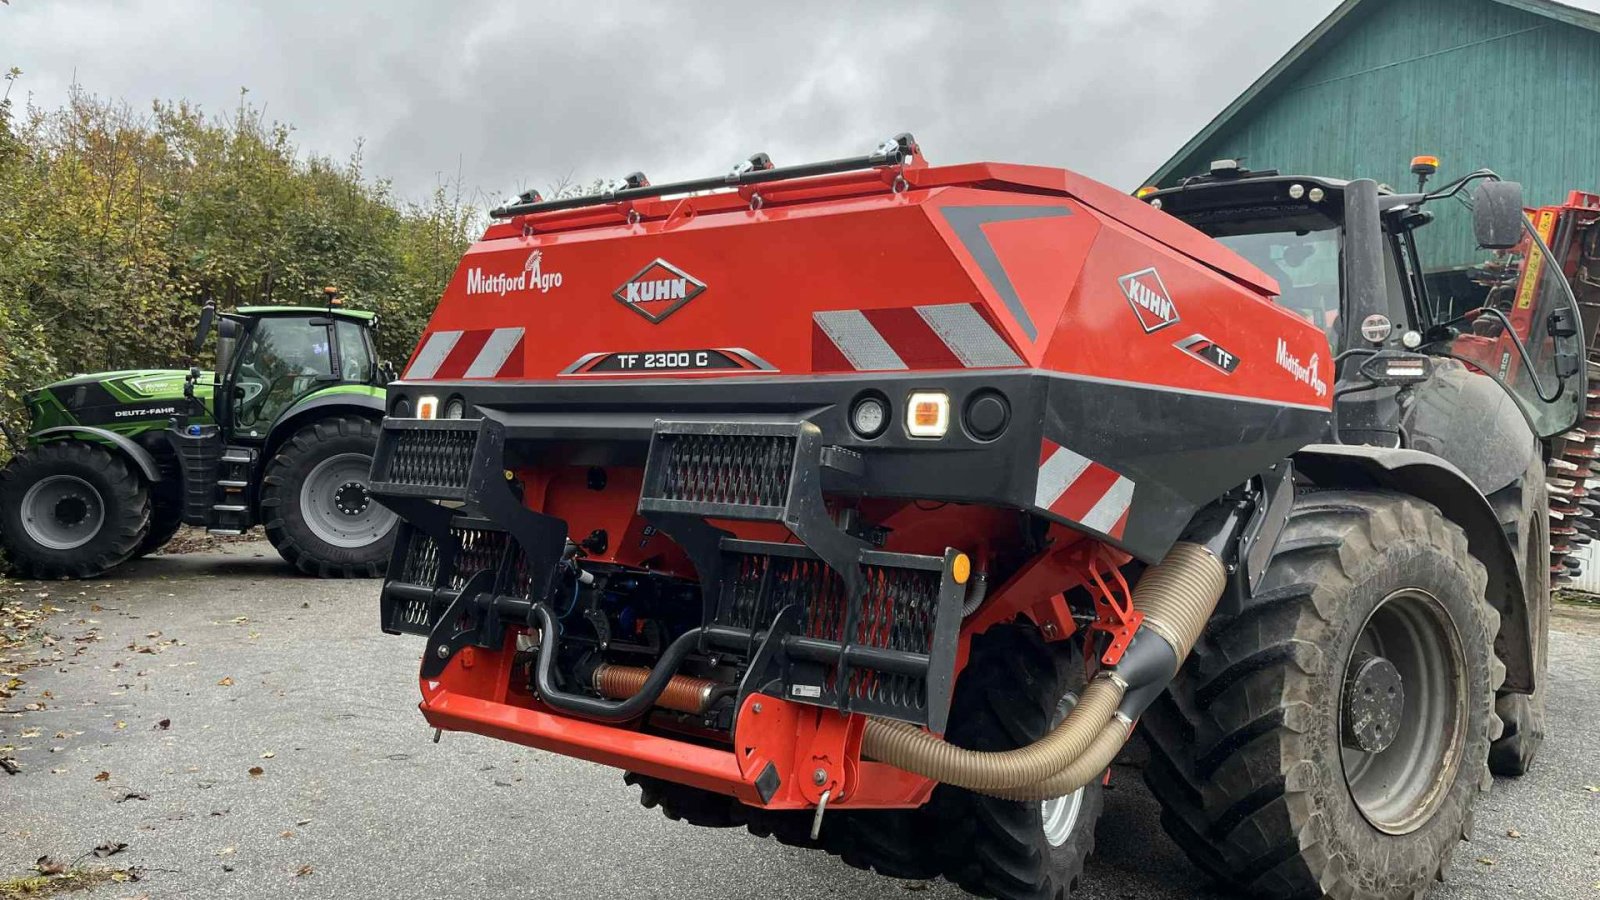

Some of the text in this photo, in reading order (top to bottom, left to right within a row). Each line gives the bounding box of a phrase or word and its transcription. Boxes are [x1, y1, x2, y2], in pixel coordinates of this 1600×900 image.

[466, 258, 562, 297] Midtfjord Agro
[626, 278, 687, 303] KUHN
[1128, 277, 1171, 322] KUHN
[617, 352, 708, 369] TF 2300 C
[1216, 347, 1233, 369] TF
[1275, 336, 1311, 383] Midtfjord
[115, 407, 175, 417] DEUTZ-FAHR
